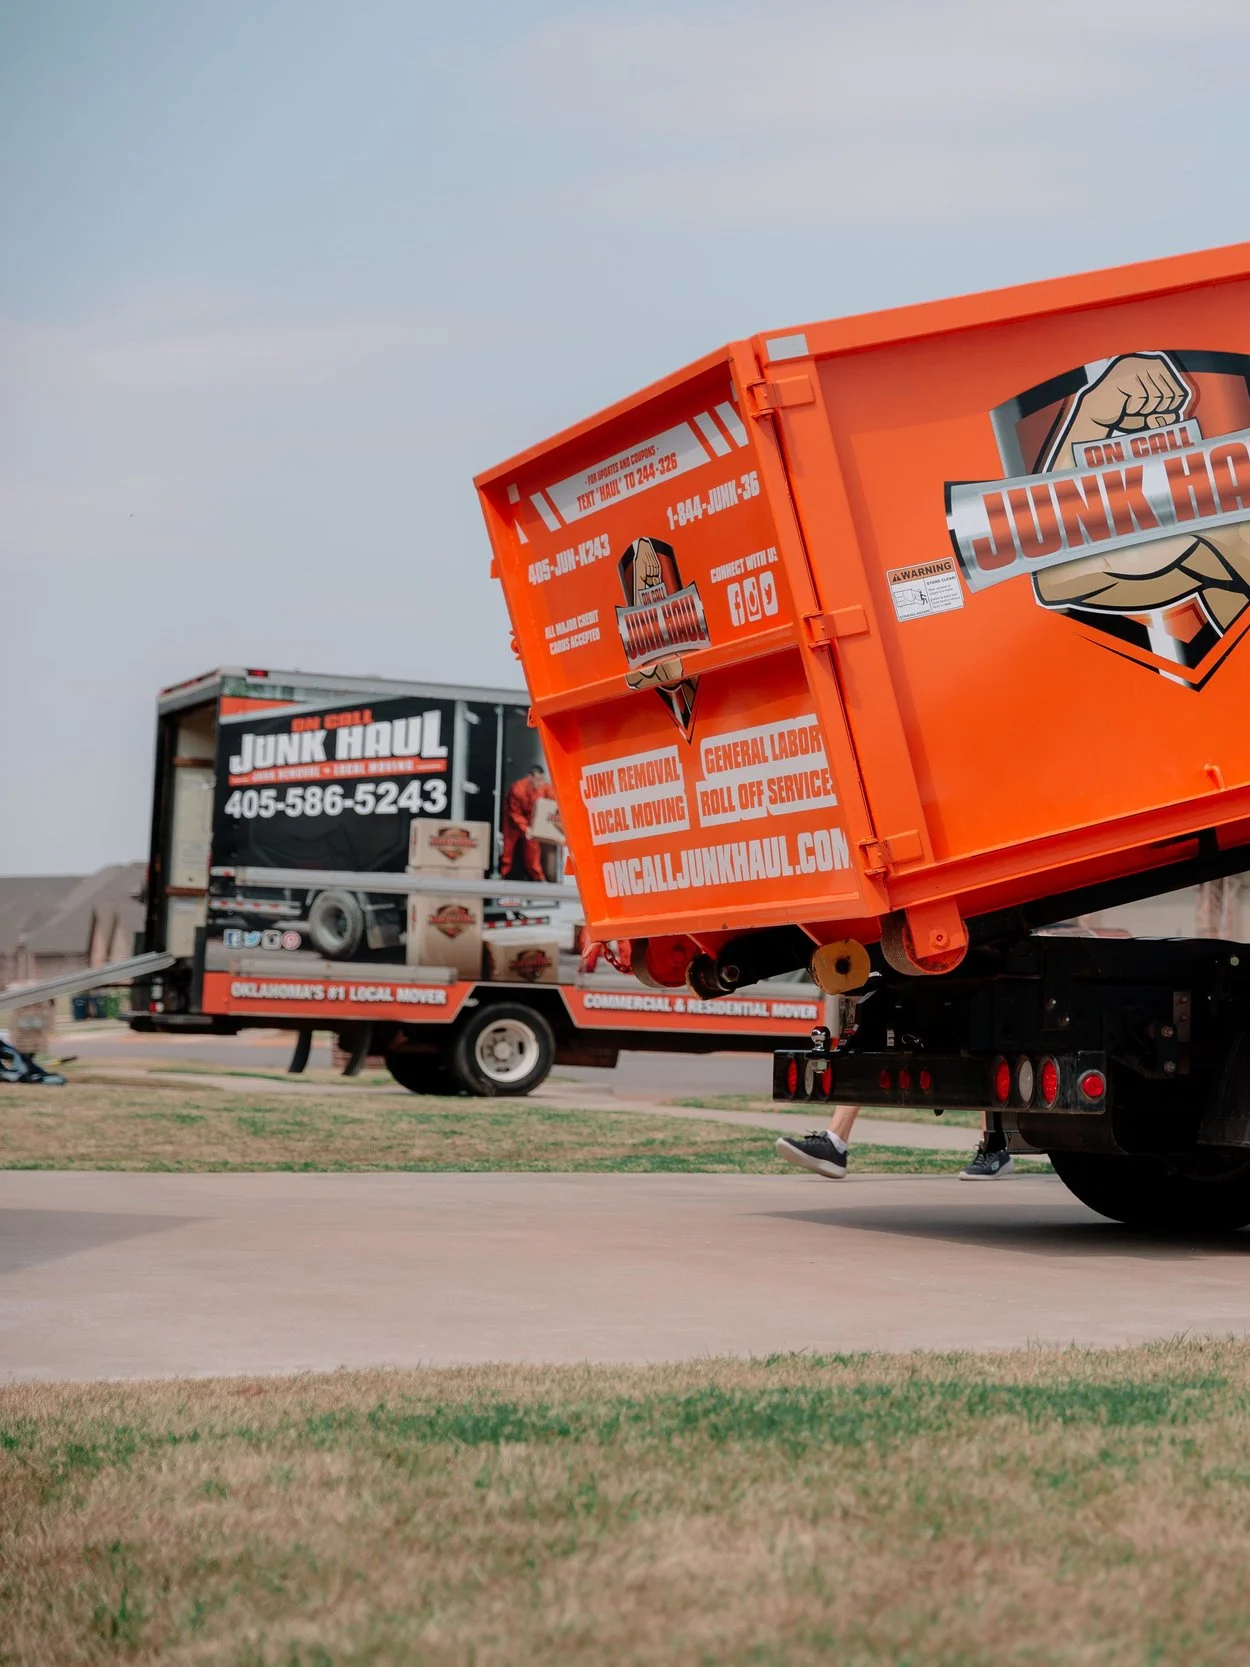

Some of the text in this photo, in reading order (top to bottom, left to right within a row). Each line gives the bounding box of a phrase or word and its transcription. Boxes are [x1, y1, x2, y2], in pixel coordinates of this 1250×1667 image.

[587, 445, 656, 486] FOR UPDATES AND COUPONS
[1083, 426, 1196, 470] ON CALL
[576, 489, 596, 512] TEXT
[623, 471, 636, 490] TO
[636, 452, 678, 485] 244-326
[970, 463, 1161, 572] JUNK
[528, 533, 611, 586] 405-JUN-K243
[710, 558, 745, 584] CONNECT
[744, 550, 768, 571] WITH
[900, 561, 952, 580] WARNING
[544, 609, 599, 640] ALL MAJOR CREDIT
[549, 627, 600, 656] CARDS ACCEPTED
[623, 593, 706, 660] JUNK HAUL
[291, 708, 375, 733] ON CALL
[229, 709, 449, 775] JUNK HAUL
[704, 724, 823, 775] GENERAL LABOR
[224, 778, 448, 819] 405-586-5243
[583, 756, 681, 800] JUNK REMOVAL
[699, 786, 736, 817] ROLL
[737, 780, 765, 810] OFF
[591, 795, 686, 836] LOCAL MOVING
[231, 981, 447, 1005] OKLAHOMA'S #1 LOCAL MOVER
[583, 993, 818, 1020] COMMERCIAL & RESIDENTIAL MOVER
